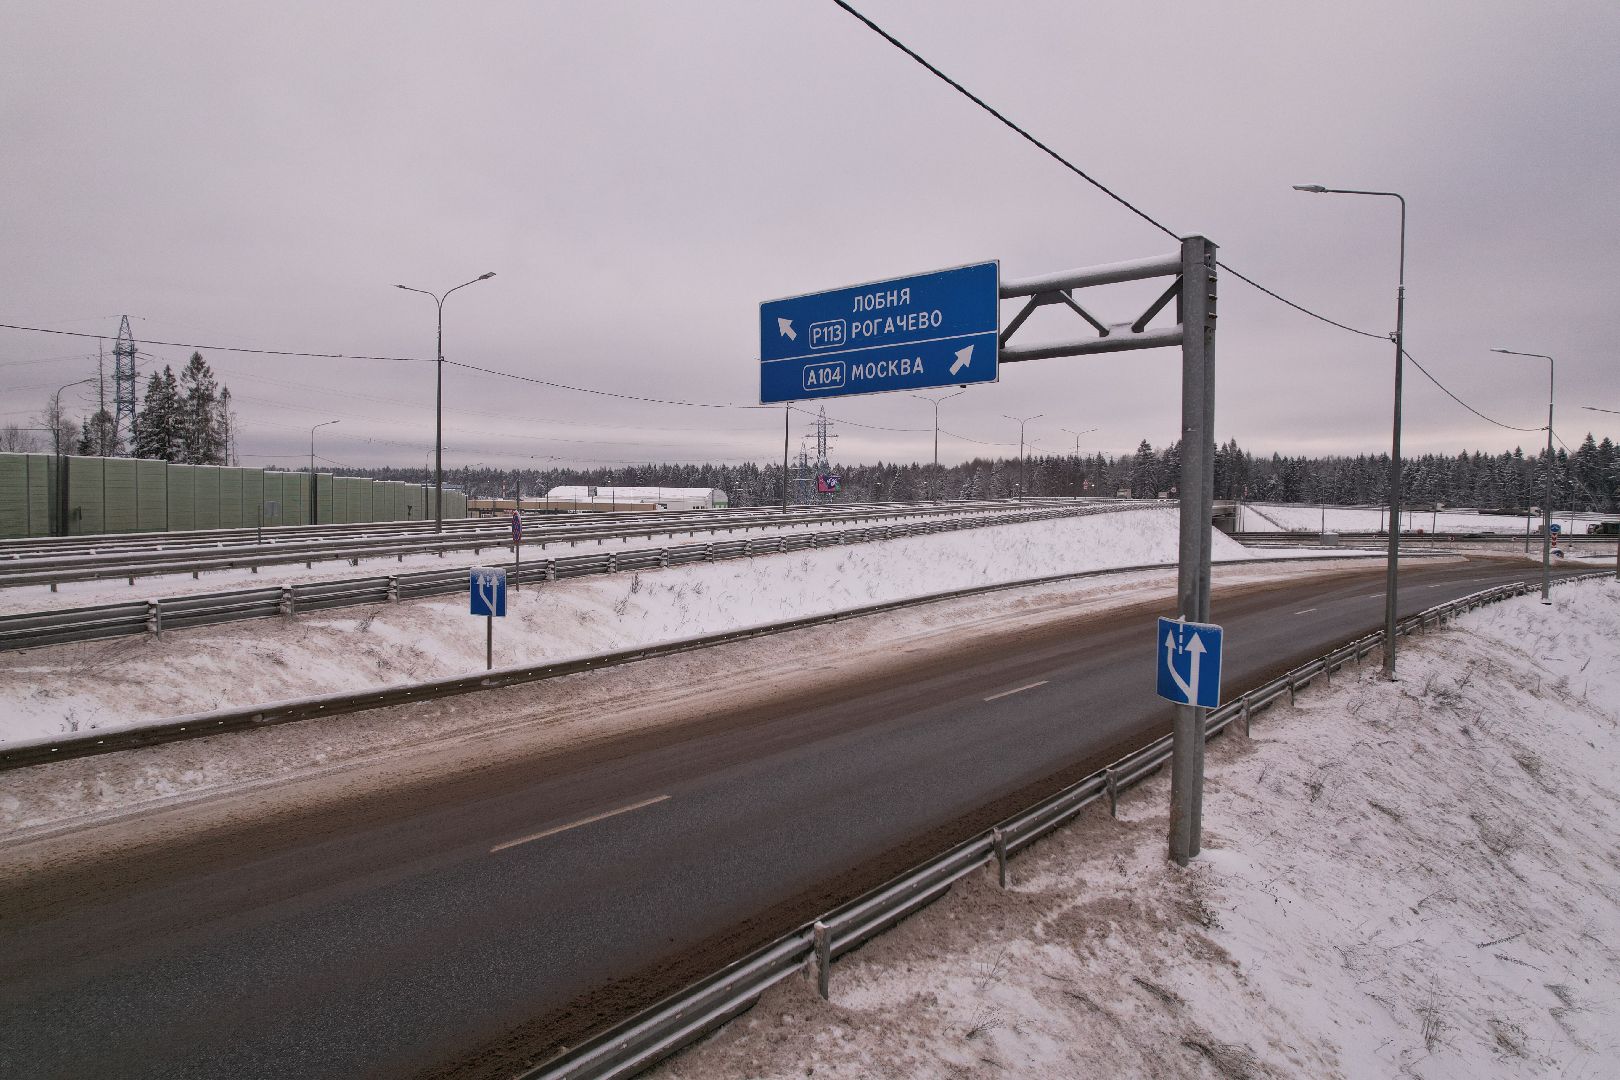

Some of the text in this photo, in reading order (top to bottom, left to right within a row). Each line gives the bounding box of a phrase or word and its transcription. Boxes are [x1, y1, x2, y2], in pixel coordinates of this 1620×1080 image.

[853, 287, 911, 313] ЛОБНЯ
[813, 310, 943, 344] Р113 РОГАЧЕВО
[807, 356, 924, 386] А104 МОСКВА
